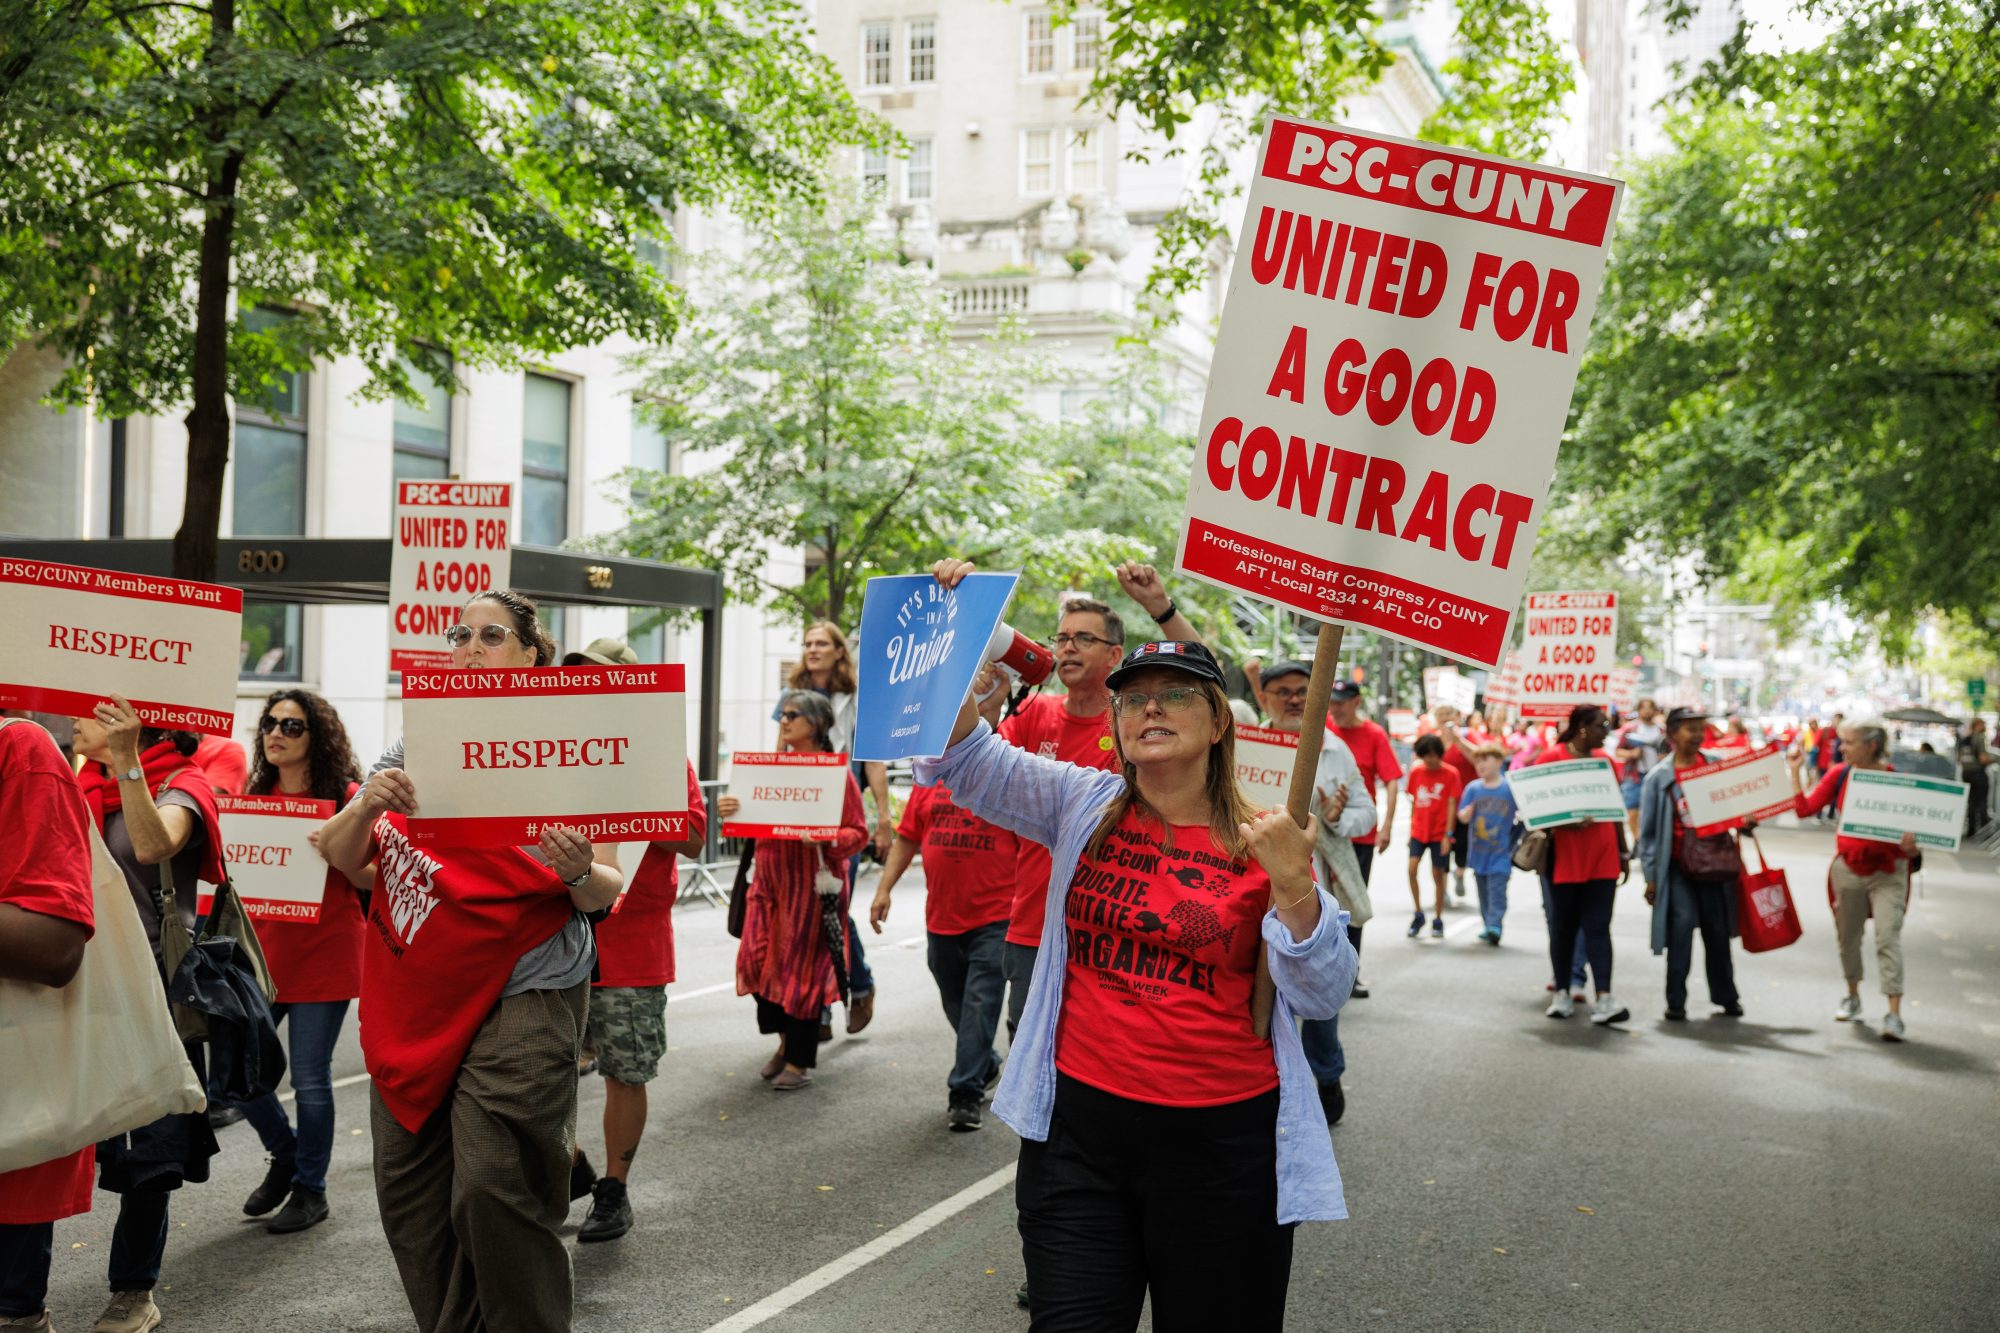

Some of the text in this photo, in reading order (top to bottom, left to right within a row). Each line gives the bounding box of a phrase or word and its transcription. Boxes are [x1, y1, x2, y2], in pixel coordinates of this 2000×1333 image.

[1287, 132, 1588, 231] PSC-CUNY
[1251, 206, 1580, 354] UNITED FOR
[1266, 325, 1497, 445] A GOOD
[405, 484, 504, 506] PSC-CUNY
[1206, 417, 1534, 570] CONTRACT
[401, 517, 506, 550] UNITED FOR
[239, 550, 284, 573] 800
[416, 561, 491, 593] A GOOD
[2, 562, 222, 603] PSC/CUNY Members Want
[1202, 531, 1297, 571] Professional
[1300, 563, 1339, 587] Staff
[1343, 574, 1424, 606] Congress
[1438, 602, 1489, 626] CUNY
[1235, 561, 1442, 631] AFT Local 2334 AFL CIO
[395, 603, 459, 636] CONT
[1529, 616, 1612, 636] UNITED FOR
[48, 624, 192, 665] RESPECT
[887, 629, 956, 685] Union
[1539, 645, 1596, 664] A GOOD
[406, 670, 657, 693] PSC/CUNY Members Want
[1524, 673, 1609, 693] CONTRACT
[462, 737, 629, 770] RESPECT
[1236, 764, 1287, 787] PECT
[233, 798, 281, 812] Members
[285, 801, 317, 814] Want
[753, 786, 823, 802] RESPECT
[225, 843, 292, 867] SPECT
[1192, 850, 1248, 877] Chapter
[1074, 860, 1150, 908] DUCATE.
[243, 902, 319, 918] eoplesCUNY
[1133, 980, 1168, 997] WEEK
